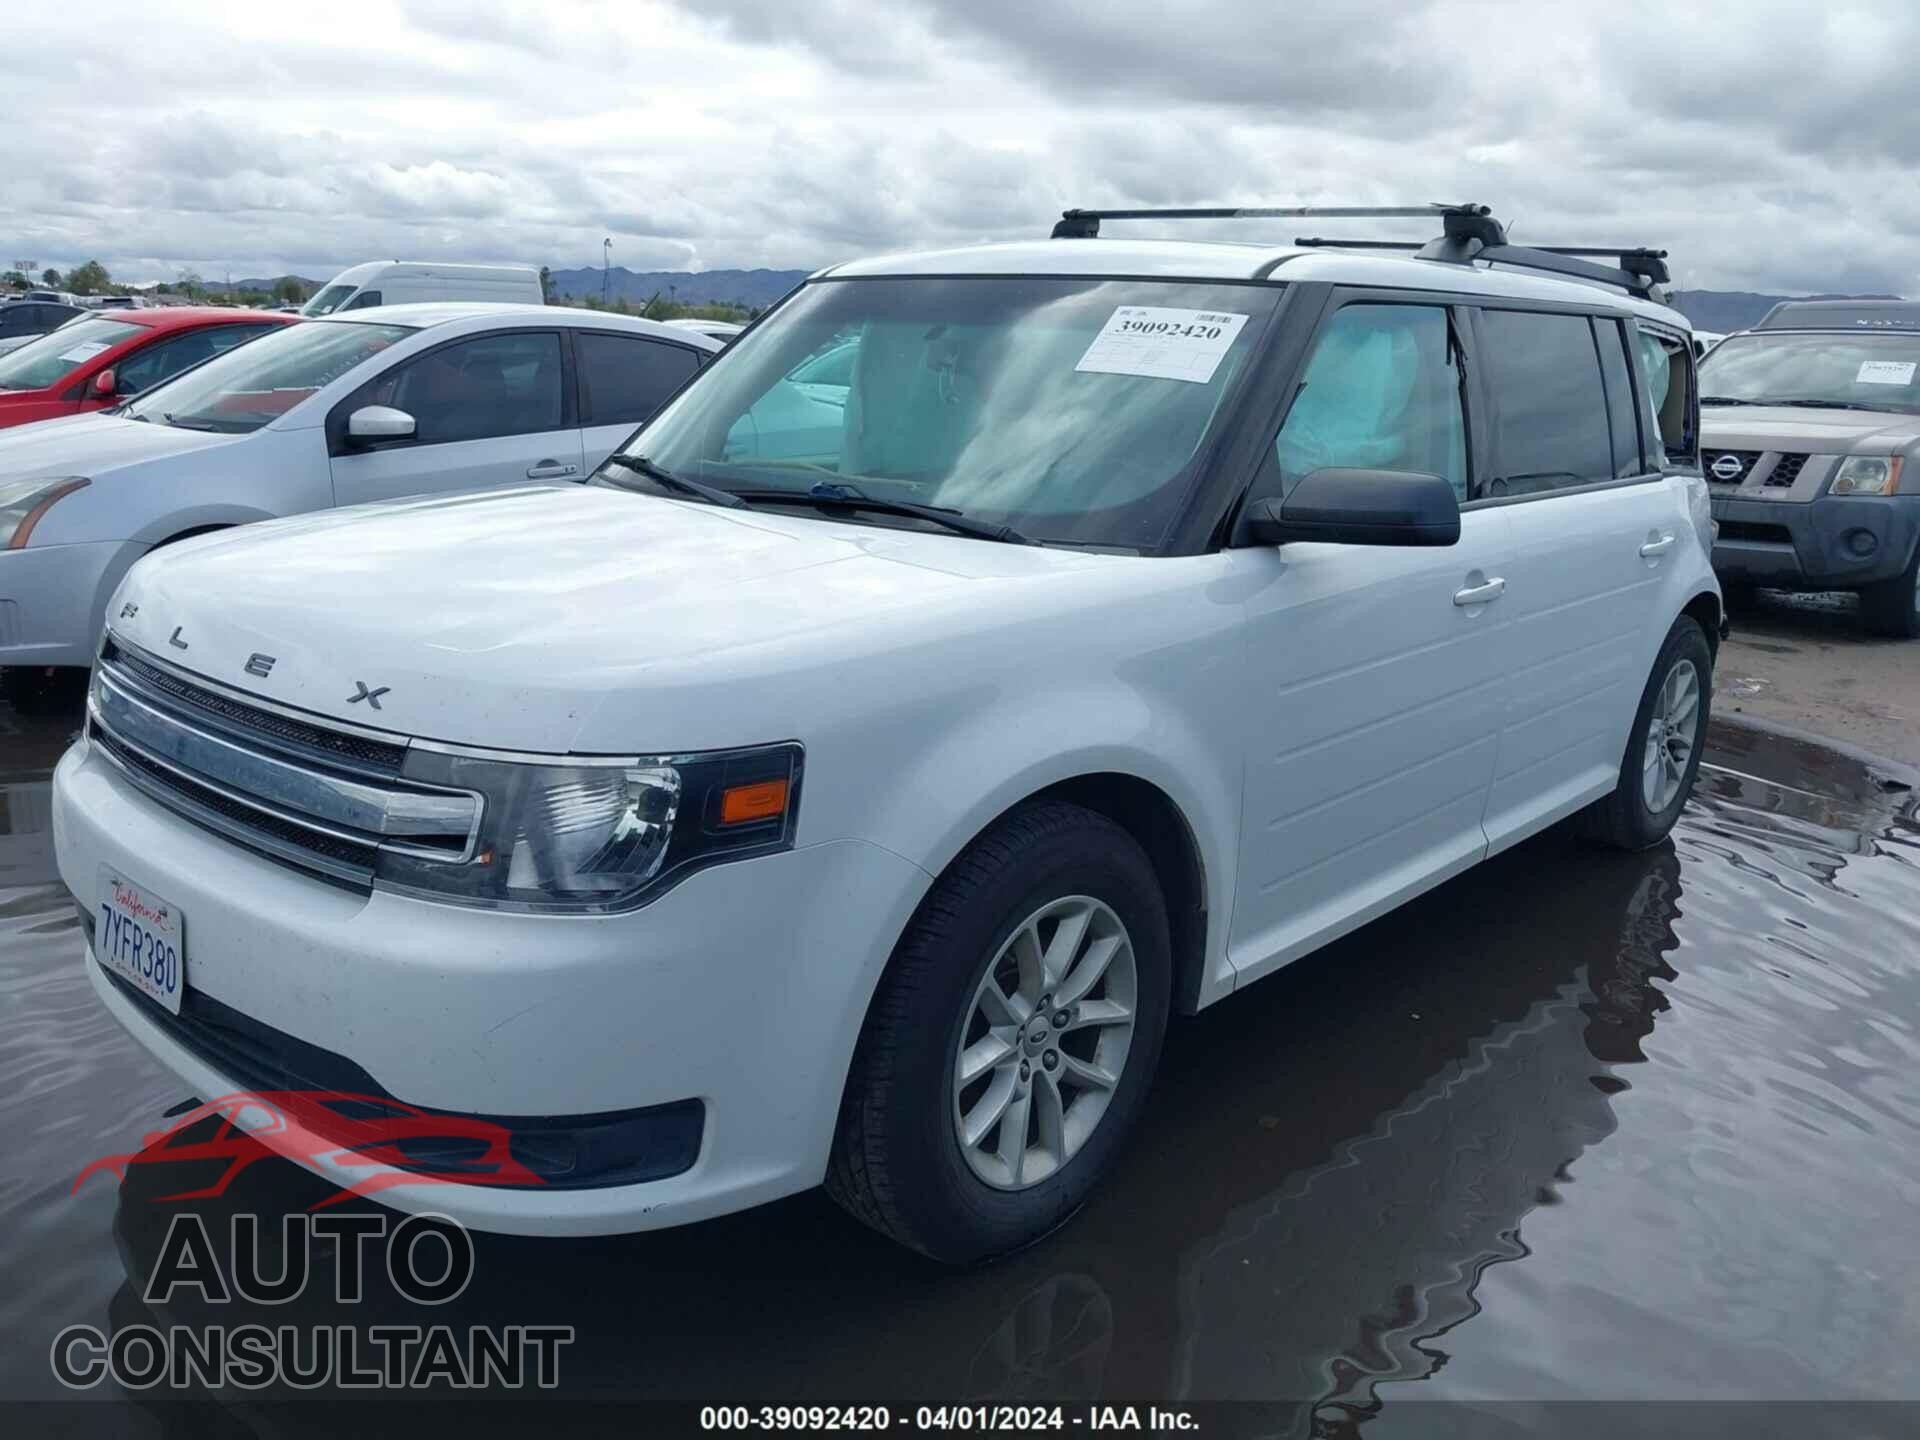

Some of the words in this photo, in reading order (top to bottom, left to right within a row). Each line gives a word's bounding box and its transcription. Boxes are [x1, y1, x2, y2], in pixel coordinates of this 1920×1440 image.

[1115, 319, 1222, 340] 39092420
[119, 602, 392, 711] FLEX
[102, 902, 177, 994] 7YFR380
